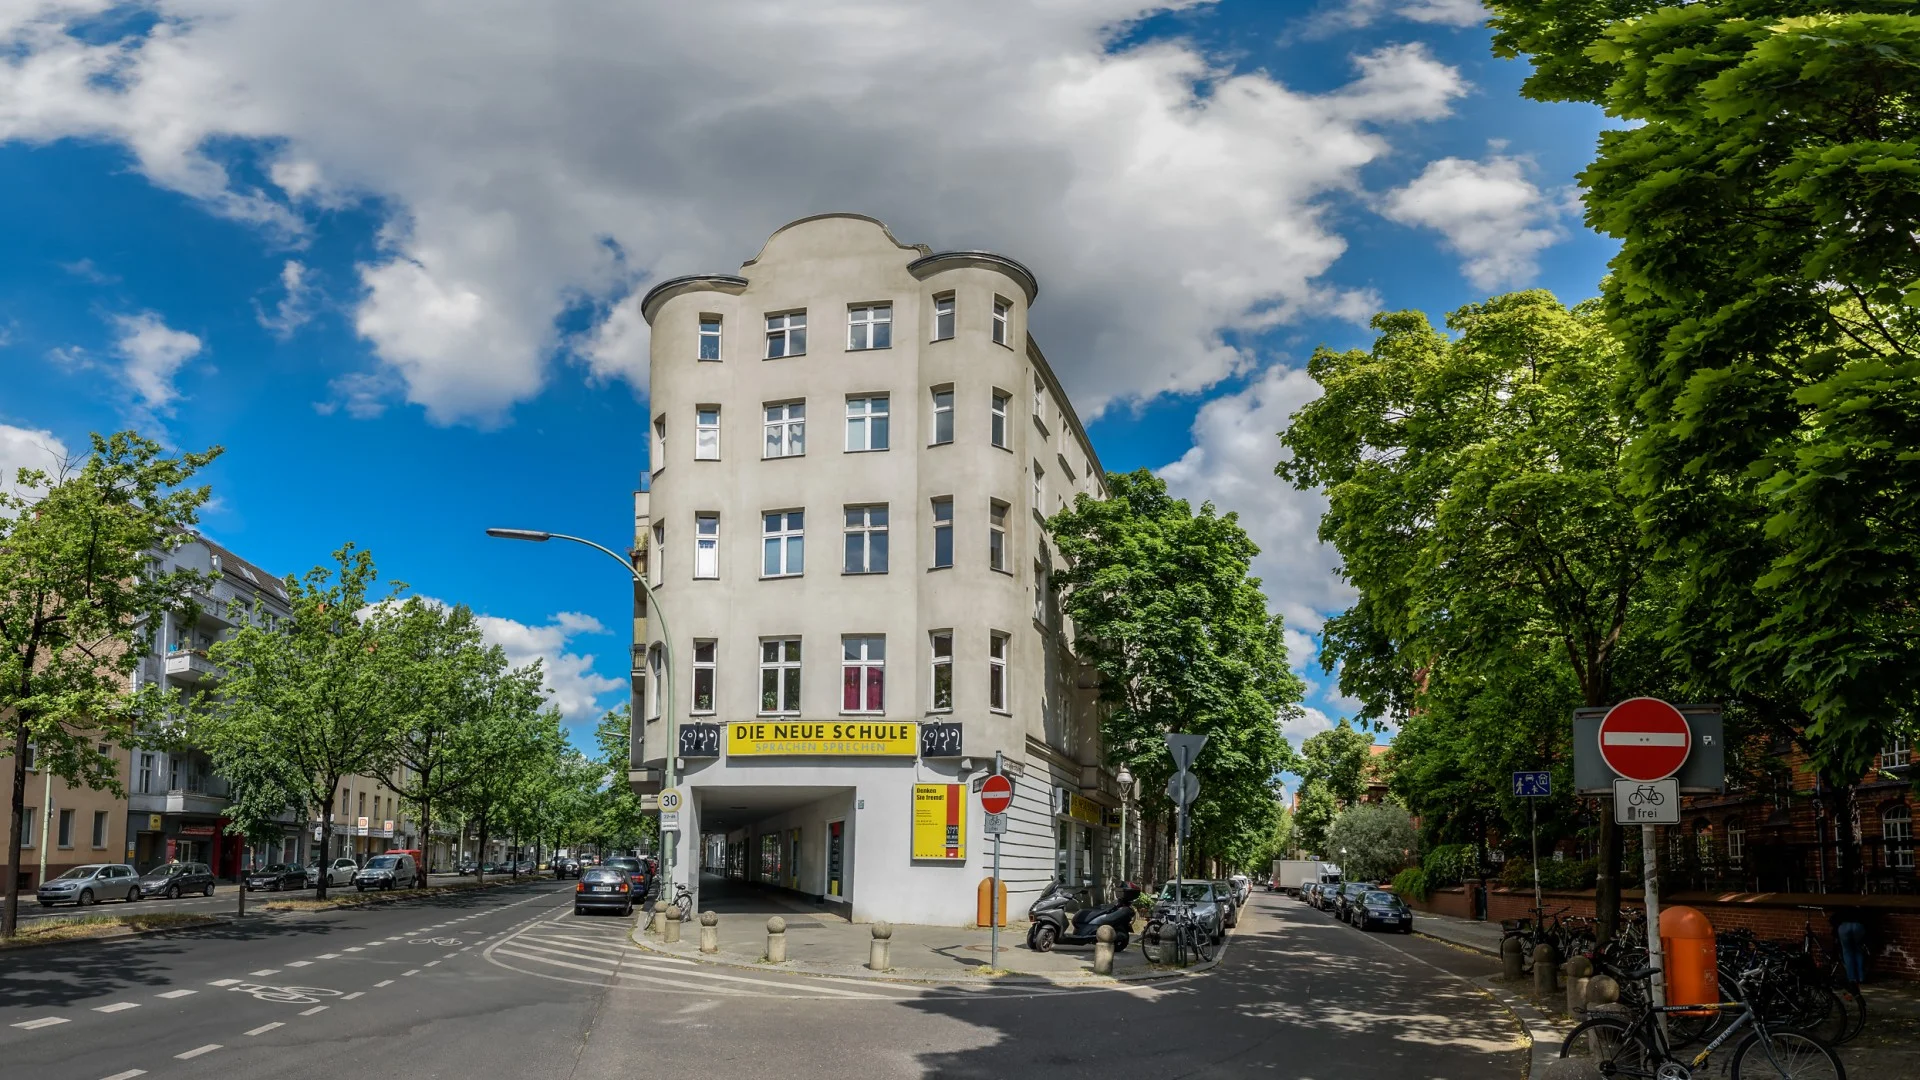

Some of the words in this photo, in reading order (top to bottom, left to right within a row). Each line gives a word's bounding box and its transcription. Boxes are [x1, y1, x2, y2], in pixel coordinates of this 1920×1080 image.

[736, 725, 765, 740] DIE
[774, 725, 824, 739] NEUE
[833, 725, 908, 740] SCHULE
[755, 743, 817, 753] SPRACHEN
[823, 742, 886, 752] SPRECHEN
[663, 795, 678, 807] 30
[1637, 808, 1657, 818] frei
